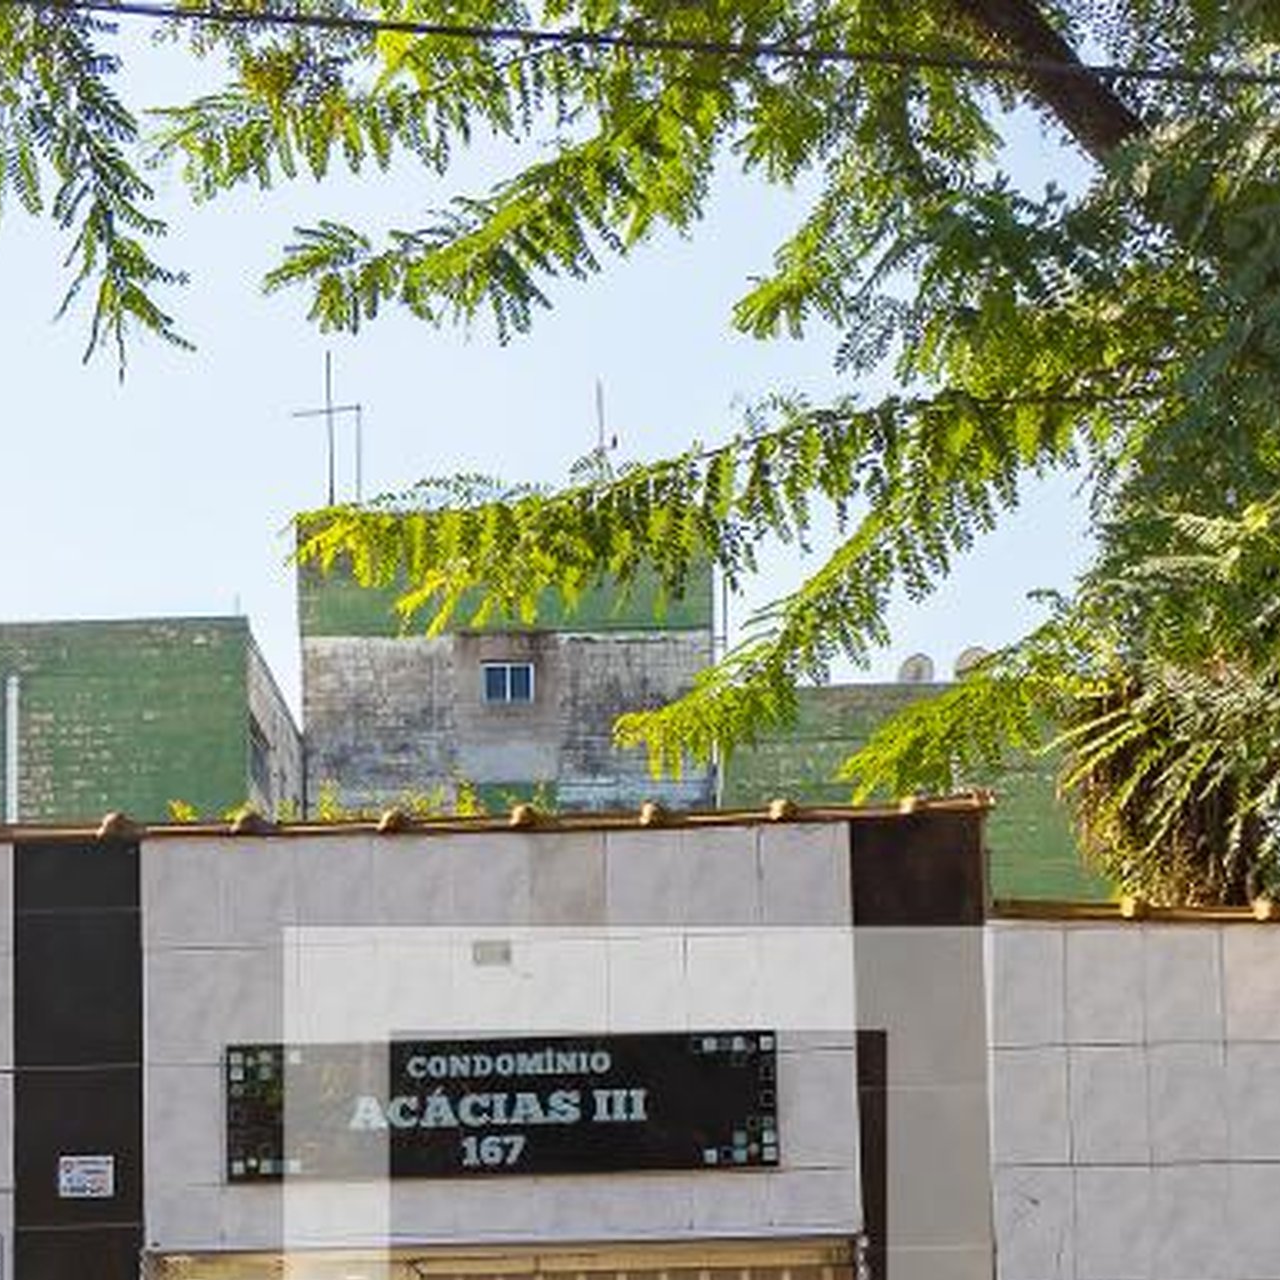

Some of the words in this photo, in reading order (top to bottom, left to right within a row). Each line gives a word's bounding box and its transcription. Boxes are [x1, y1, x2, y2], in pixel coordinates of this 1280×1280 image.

[407, 1049, 611, 1079] CONDOMÍNIO
[349, 1086, 581, 1130] ACÁCIAS
[591, 1089, 648, 1122] III
[461, 1135, 527, 1166] 167
